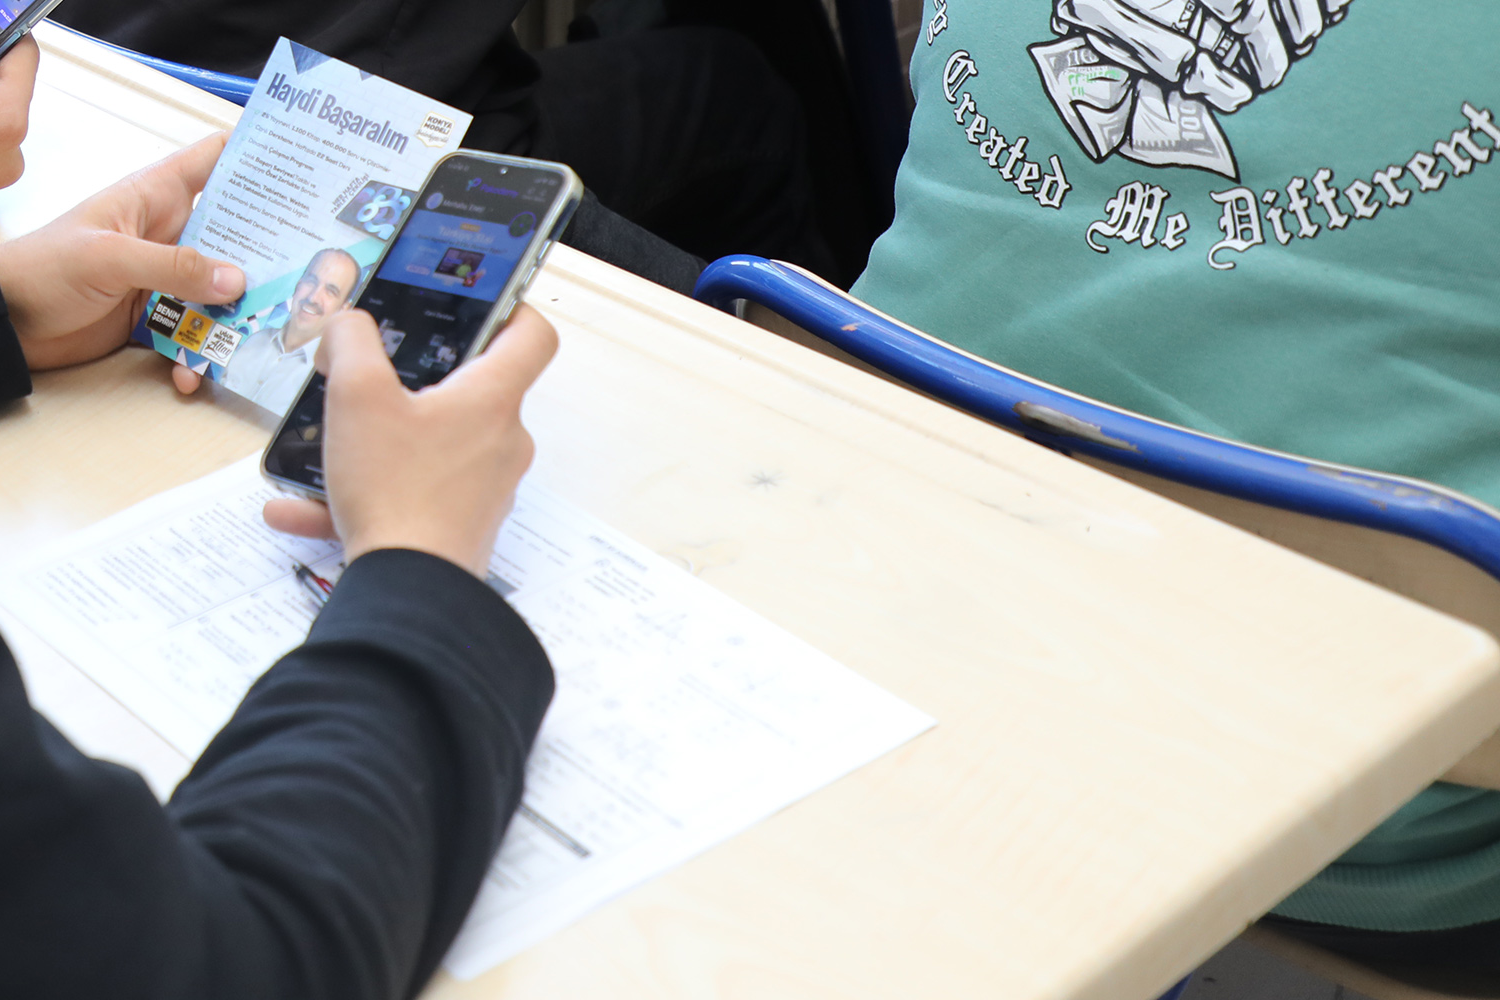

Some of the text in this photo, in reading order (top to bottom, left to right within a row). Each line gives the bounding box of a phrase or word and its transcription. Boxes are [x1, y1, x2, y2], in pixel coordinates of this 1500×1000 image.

[266, 72, 409, 154] Haydi Başaralım
[427, 115, 452, 130] KONYA
[320, 138, 347, 154] 400.000
[942, 50, 1073, 210] Created
[1085, 180, 1190, 253] Me
[1207, 102, 1500, 270] Different
[151, 312, 176, 330] ŞEHRİM
[156, 303, 181, 321] BENİM
